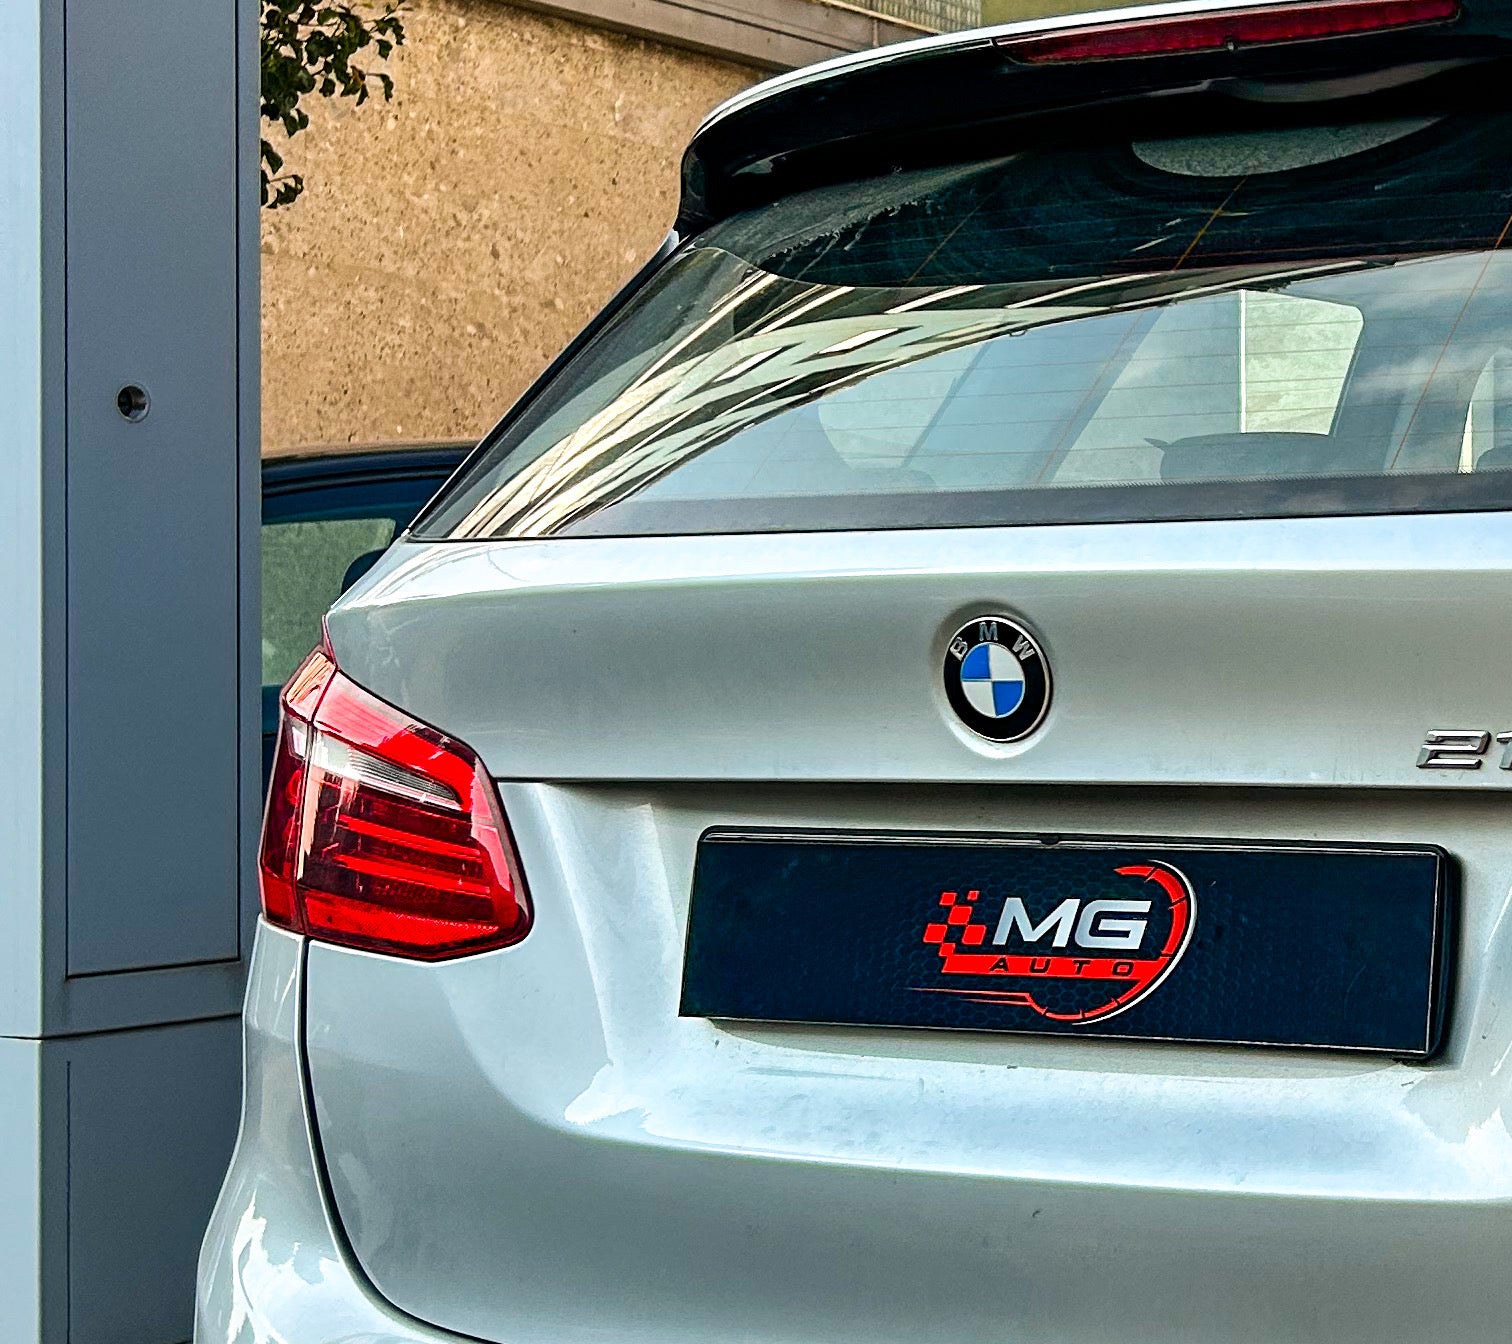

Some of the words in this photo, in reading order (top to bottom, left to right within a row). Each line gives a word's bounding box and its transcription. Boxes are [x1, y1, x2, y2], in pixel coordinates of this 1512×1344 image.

[949, 621, 1036, 662] BMW
[991, 897, 1152, 950] MG
[989, 959, 1135, 977] AUTO
